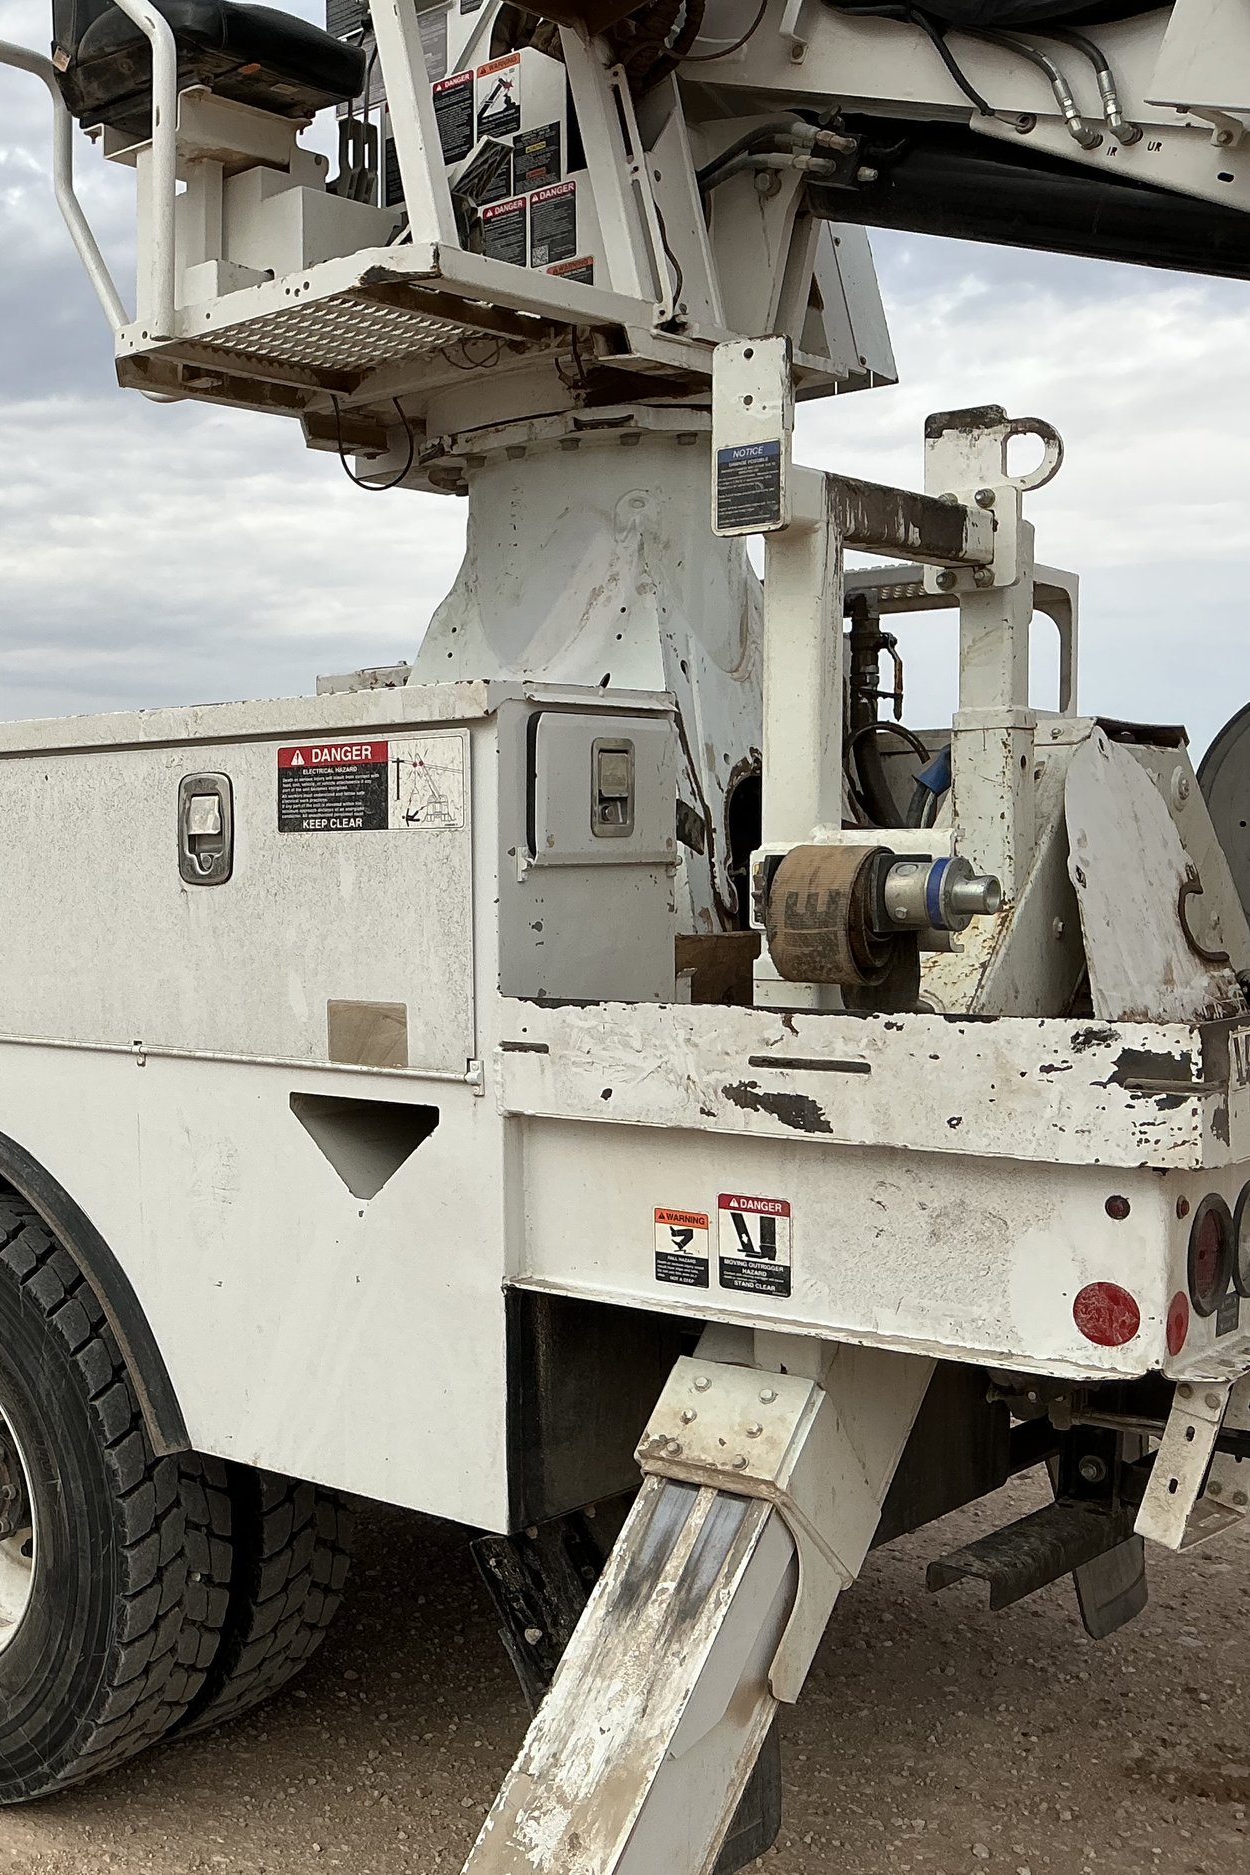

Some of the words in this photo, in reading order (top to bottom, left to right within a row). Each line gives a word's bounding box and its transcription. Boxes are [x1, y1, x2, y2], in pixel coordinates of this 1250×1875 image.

[445, 74, 470, 87] DANGER
[1106, 146, 1117, 156] IR
[1148, 141, 1162, 152] UR
[540, 182, 574, 200] DANGER
[494, 200, 523, 214] DANGER
[733, 446, 764, 458] NOTICE
[312, 746, 372, 762] DANGER
[302, 818, 328, 829] KEEP
[330, 818, 363, 828] CLEAR
[740, 1198, 782, 1212] DANGER
[666, 1212, 705, 1225] WARNING
[724, 1259, 747, 1267] MOVING
[748, 1262, 784, 1272] OUTRIGGER
[742, 1268, 767, 1277] HAZARD
[755, 1283, 776, 1291] CLEAR
